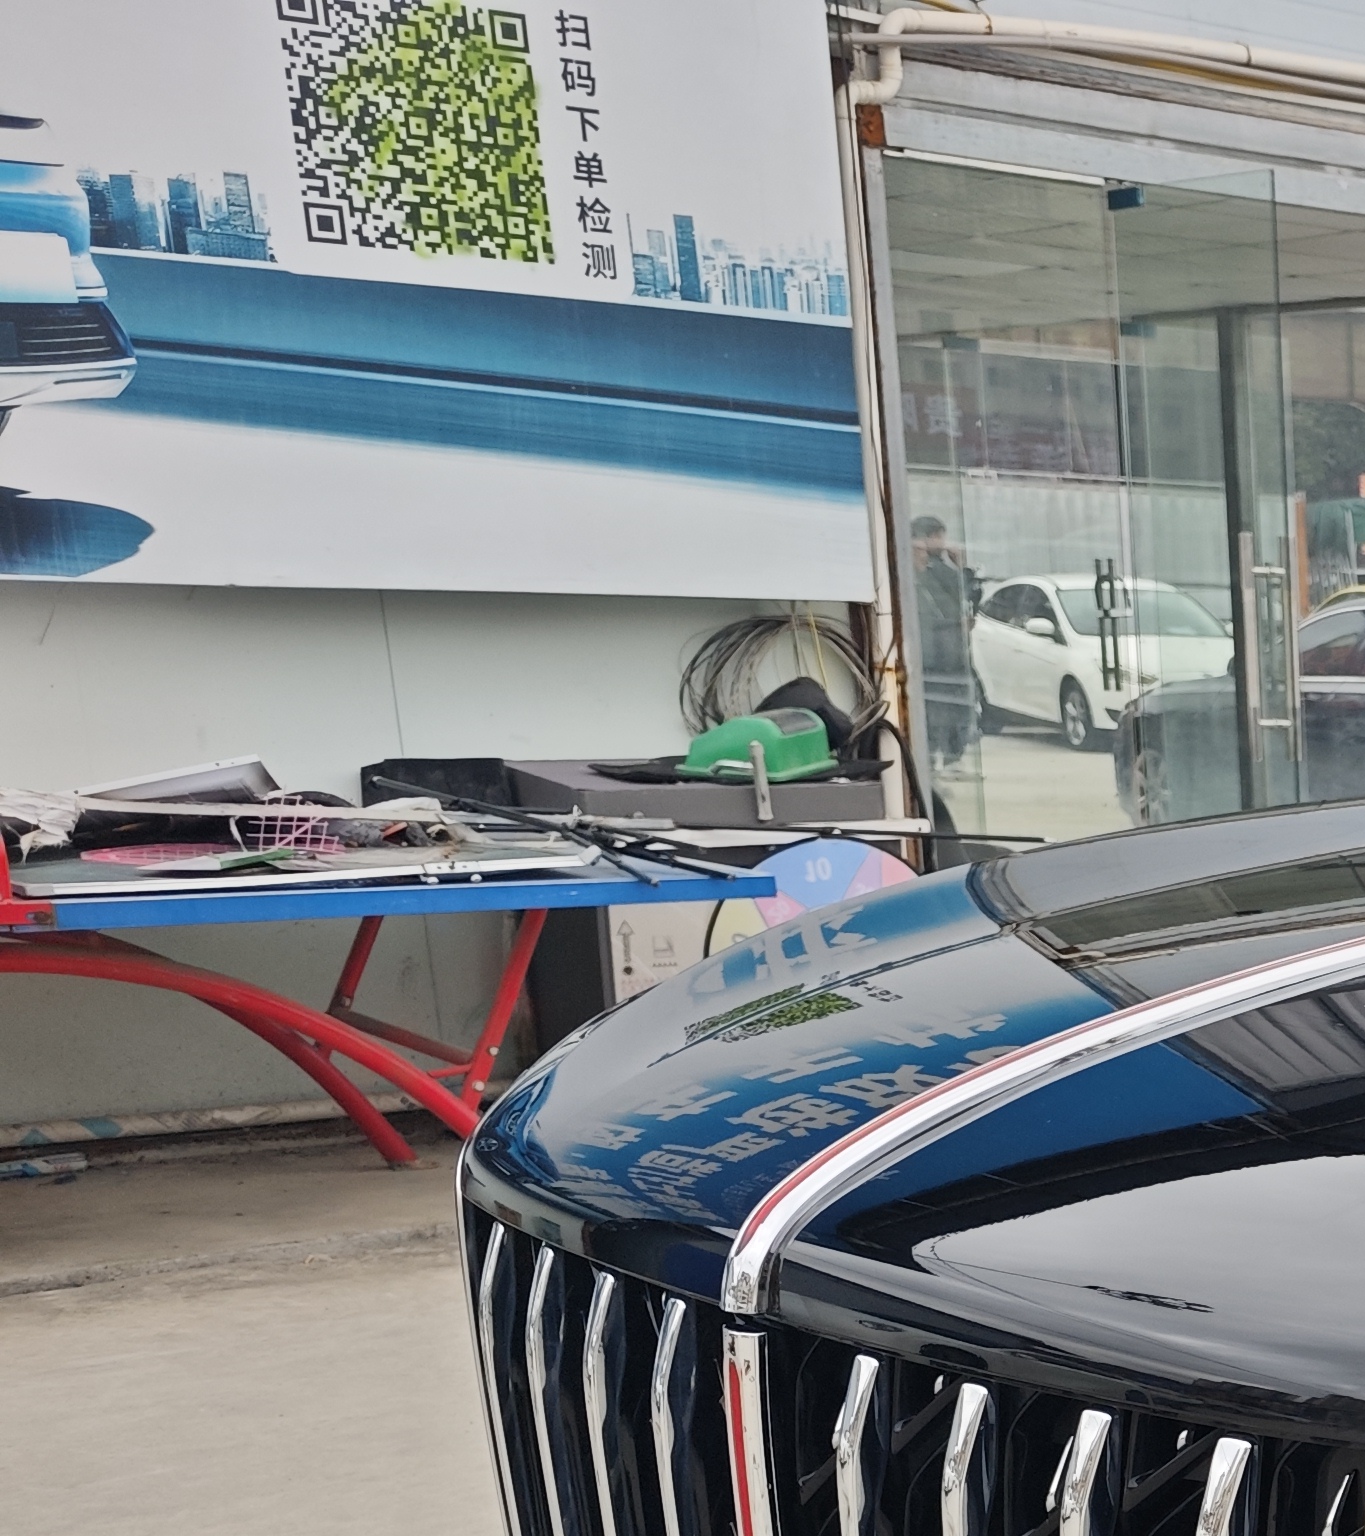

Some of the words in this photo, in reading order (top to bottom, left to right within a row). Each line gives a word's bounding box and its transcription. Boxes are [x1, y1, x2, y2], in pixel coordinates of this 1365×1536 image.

[553, 8, 618, 281] 扫码下单检测
